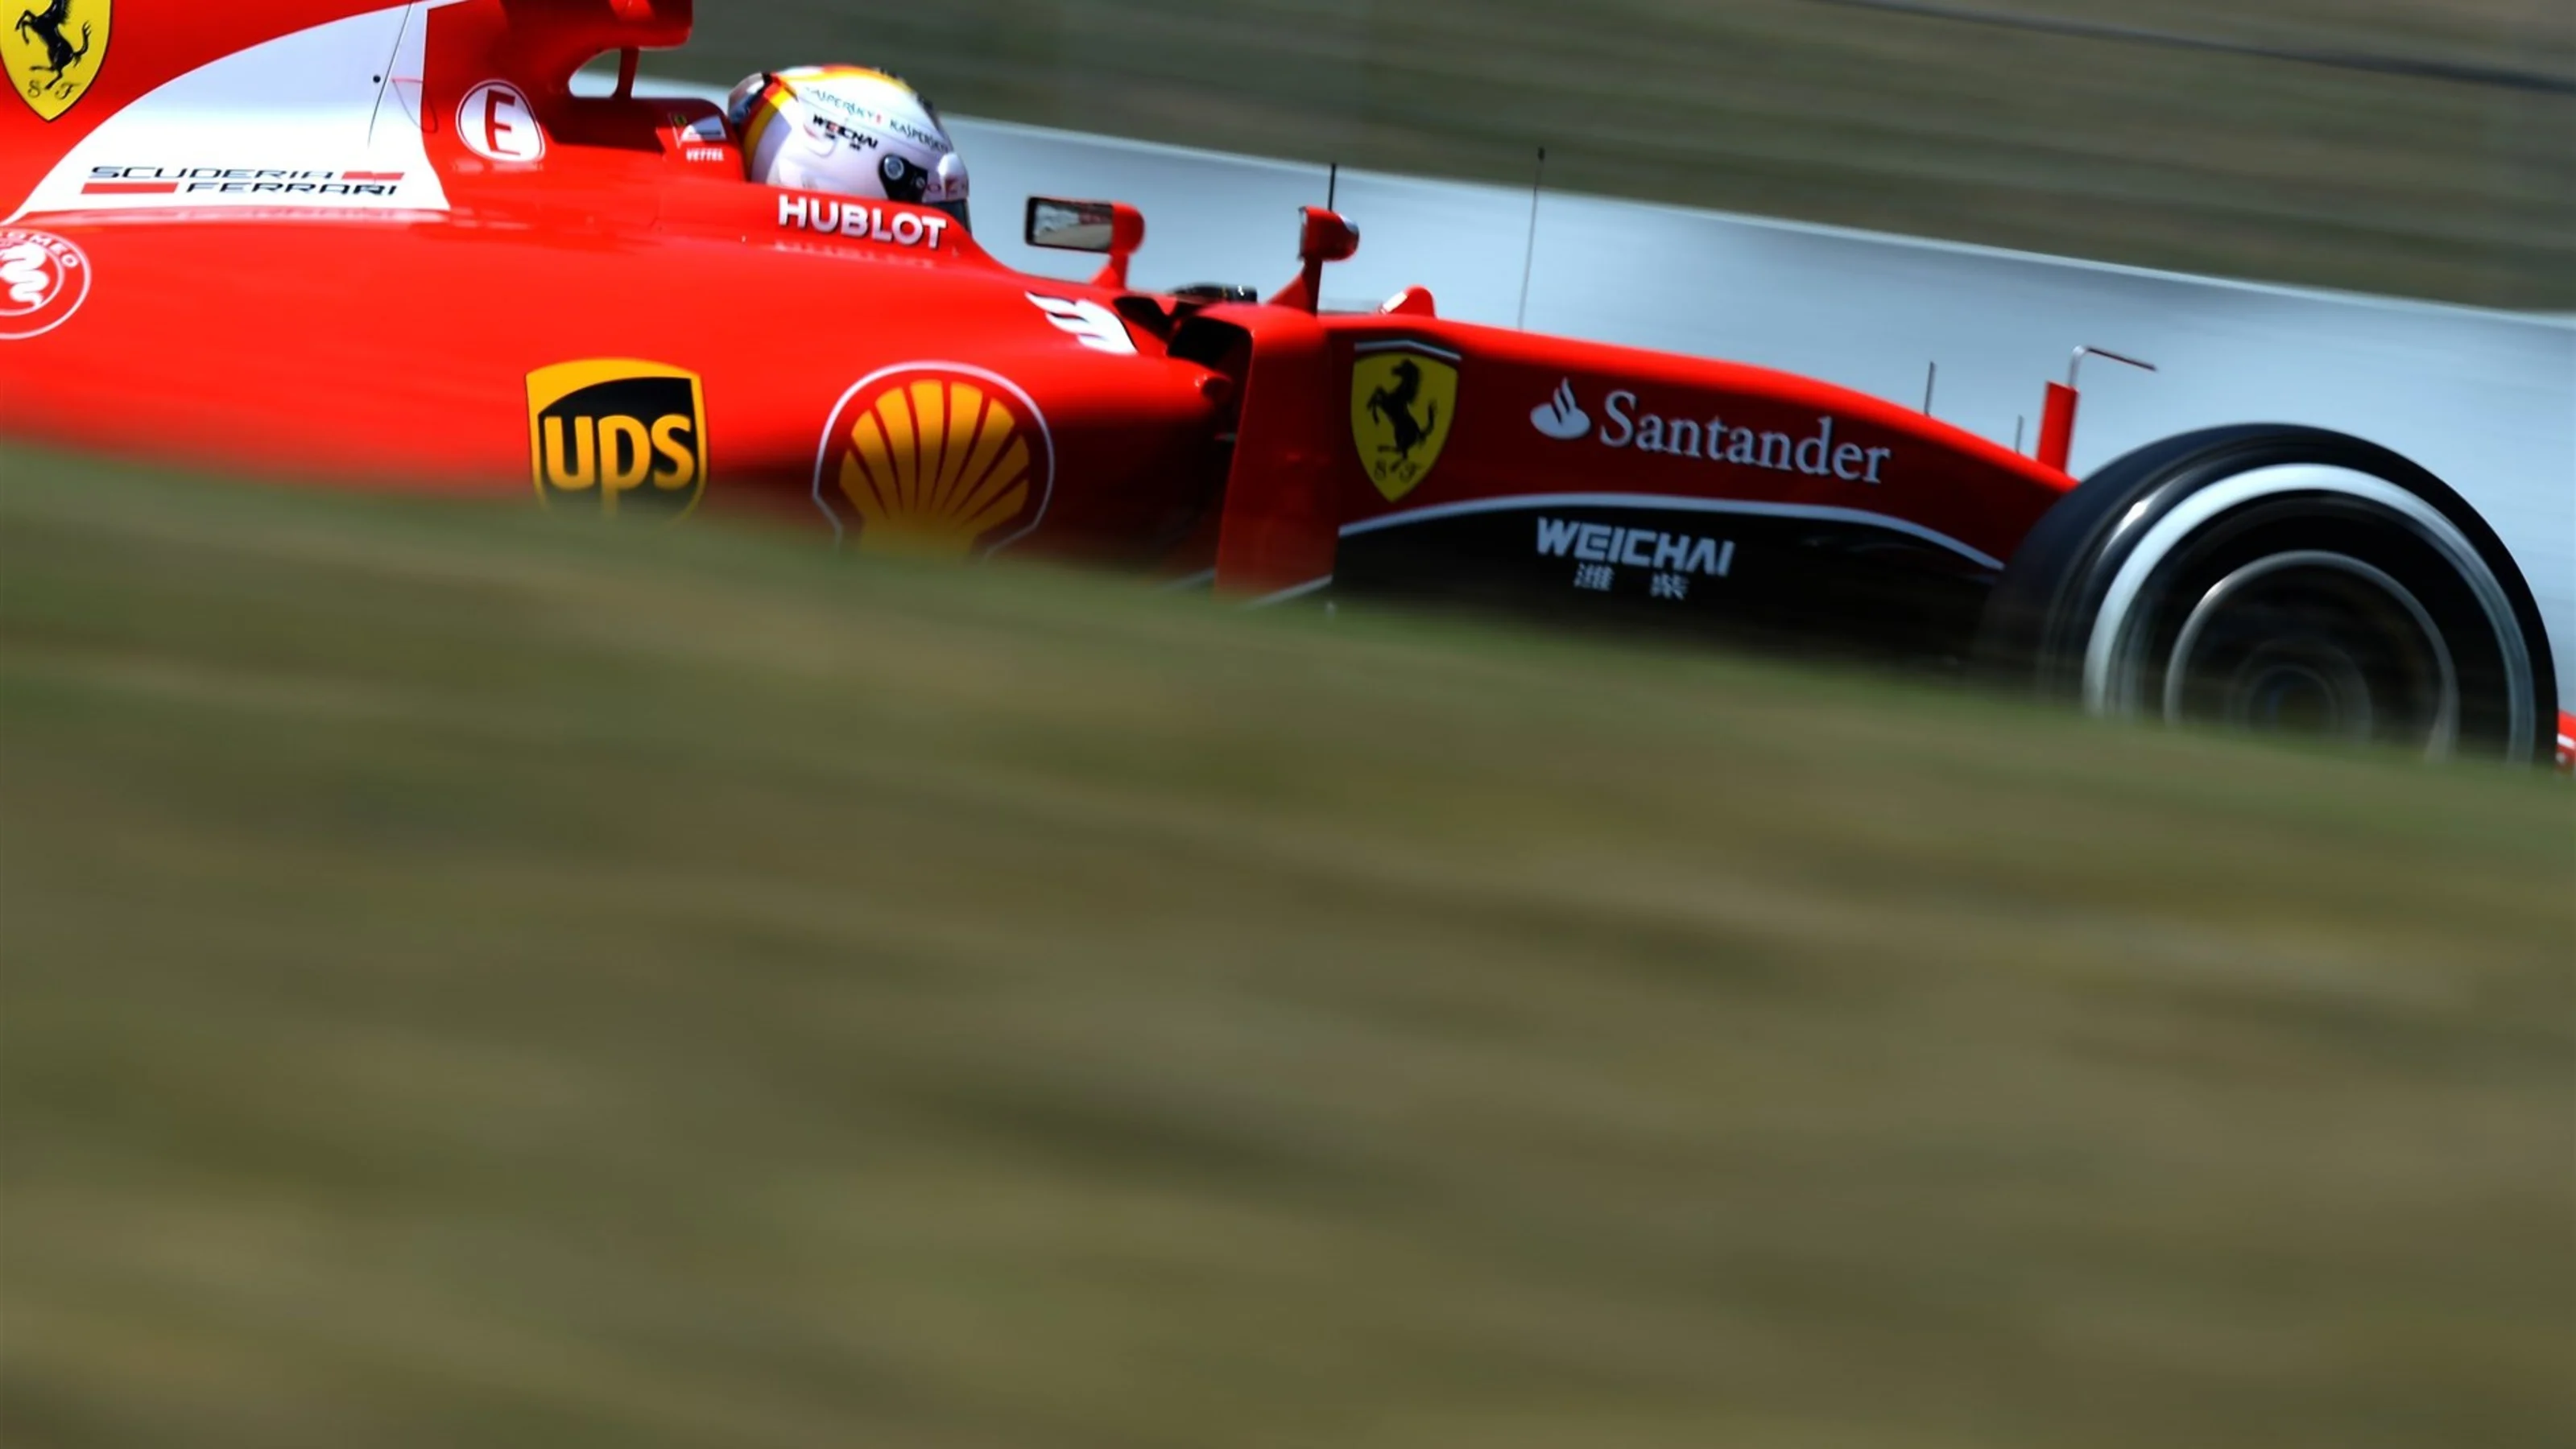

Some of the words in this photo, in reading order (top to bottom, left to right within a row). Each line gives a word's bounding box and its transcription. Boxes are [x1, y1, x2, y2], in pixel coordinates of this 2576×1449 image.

[484, 89, 521, 155] E
[88, 166, 334, 180] SCUDERIA
[186, 183, 398, 196] FERRARI
[0, 230, 79, 268] OMEO
[778, 194, 947, 250] HUBLOT
[1599, 389, 1892, 485] Santander
[1536, 516, 1735, 578] WEICHAI
